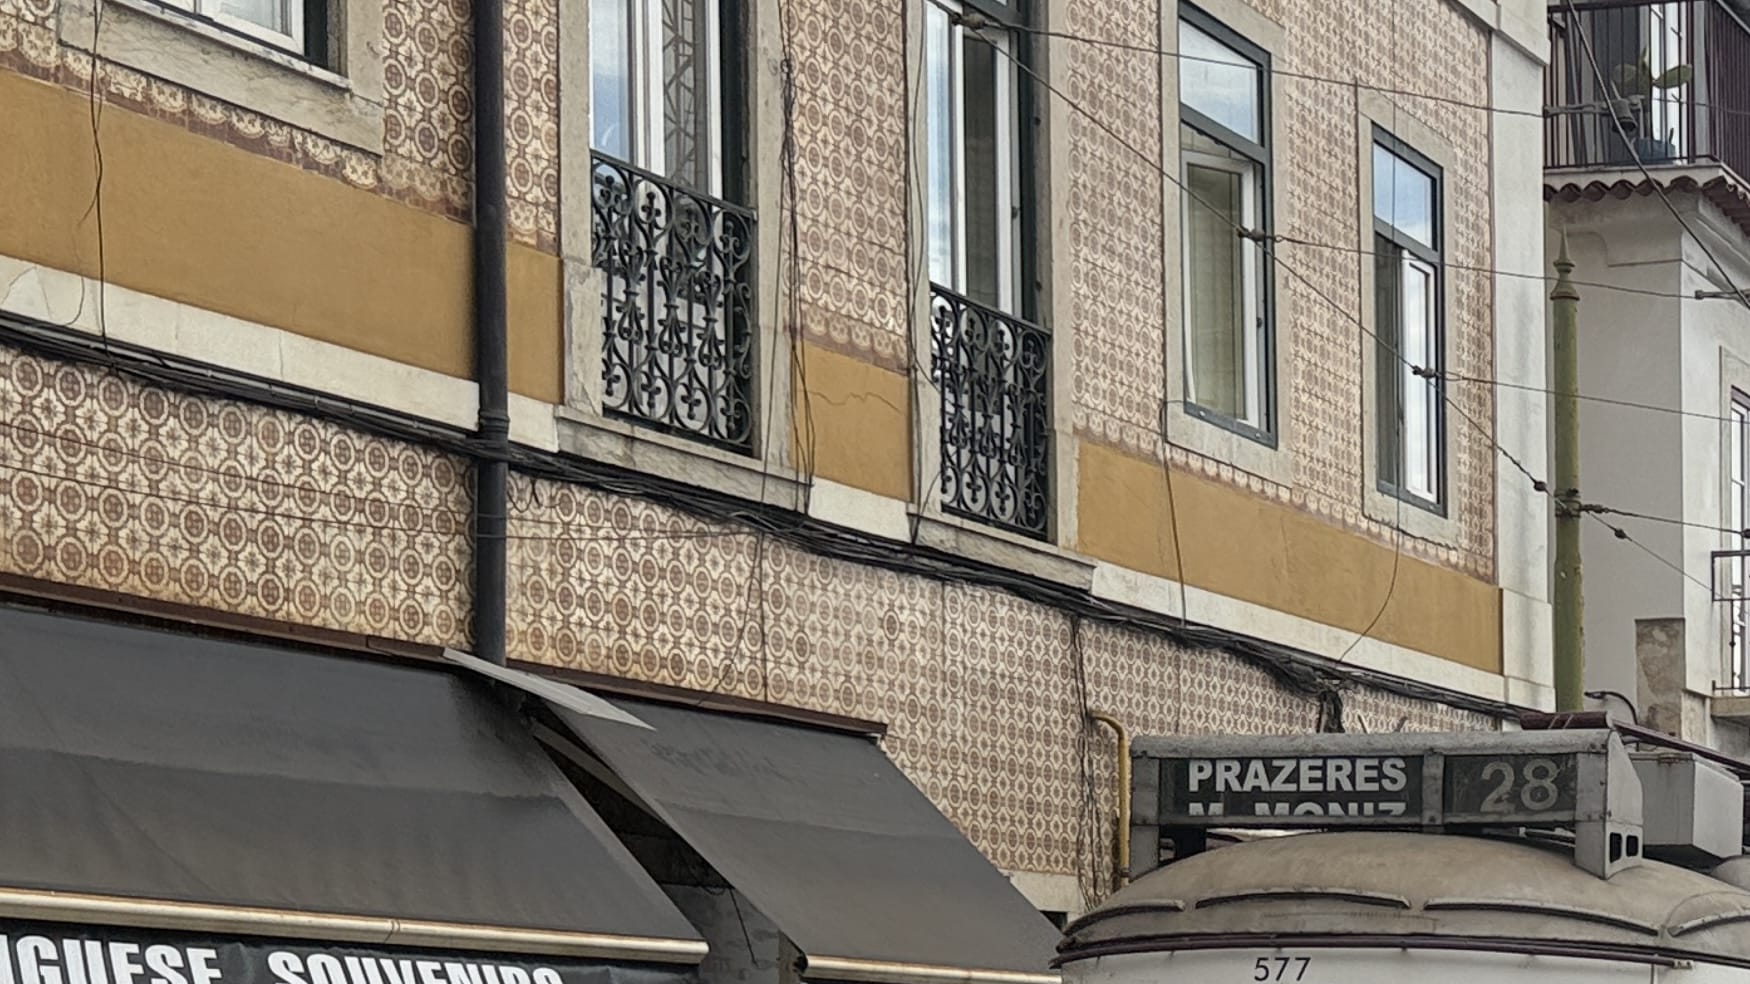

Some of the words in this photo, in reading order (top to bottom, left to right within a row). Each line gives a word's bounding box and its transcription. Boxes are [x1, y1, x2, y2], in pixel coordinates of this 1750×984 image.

[1188, 757, 1408, 793] PRAZERES
[1479, 758, 1559, 814] 28
[1254, 956, 1312, 982] 577
